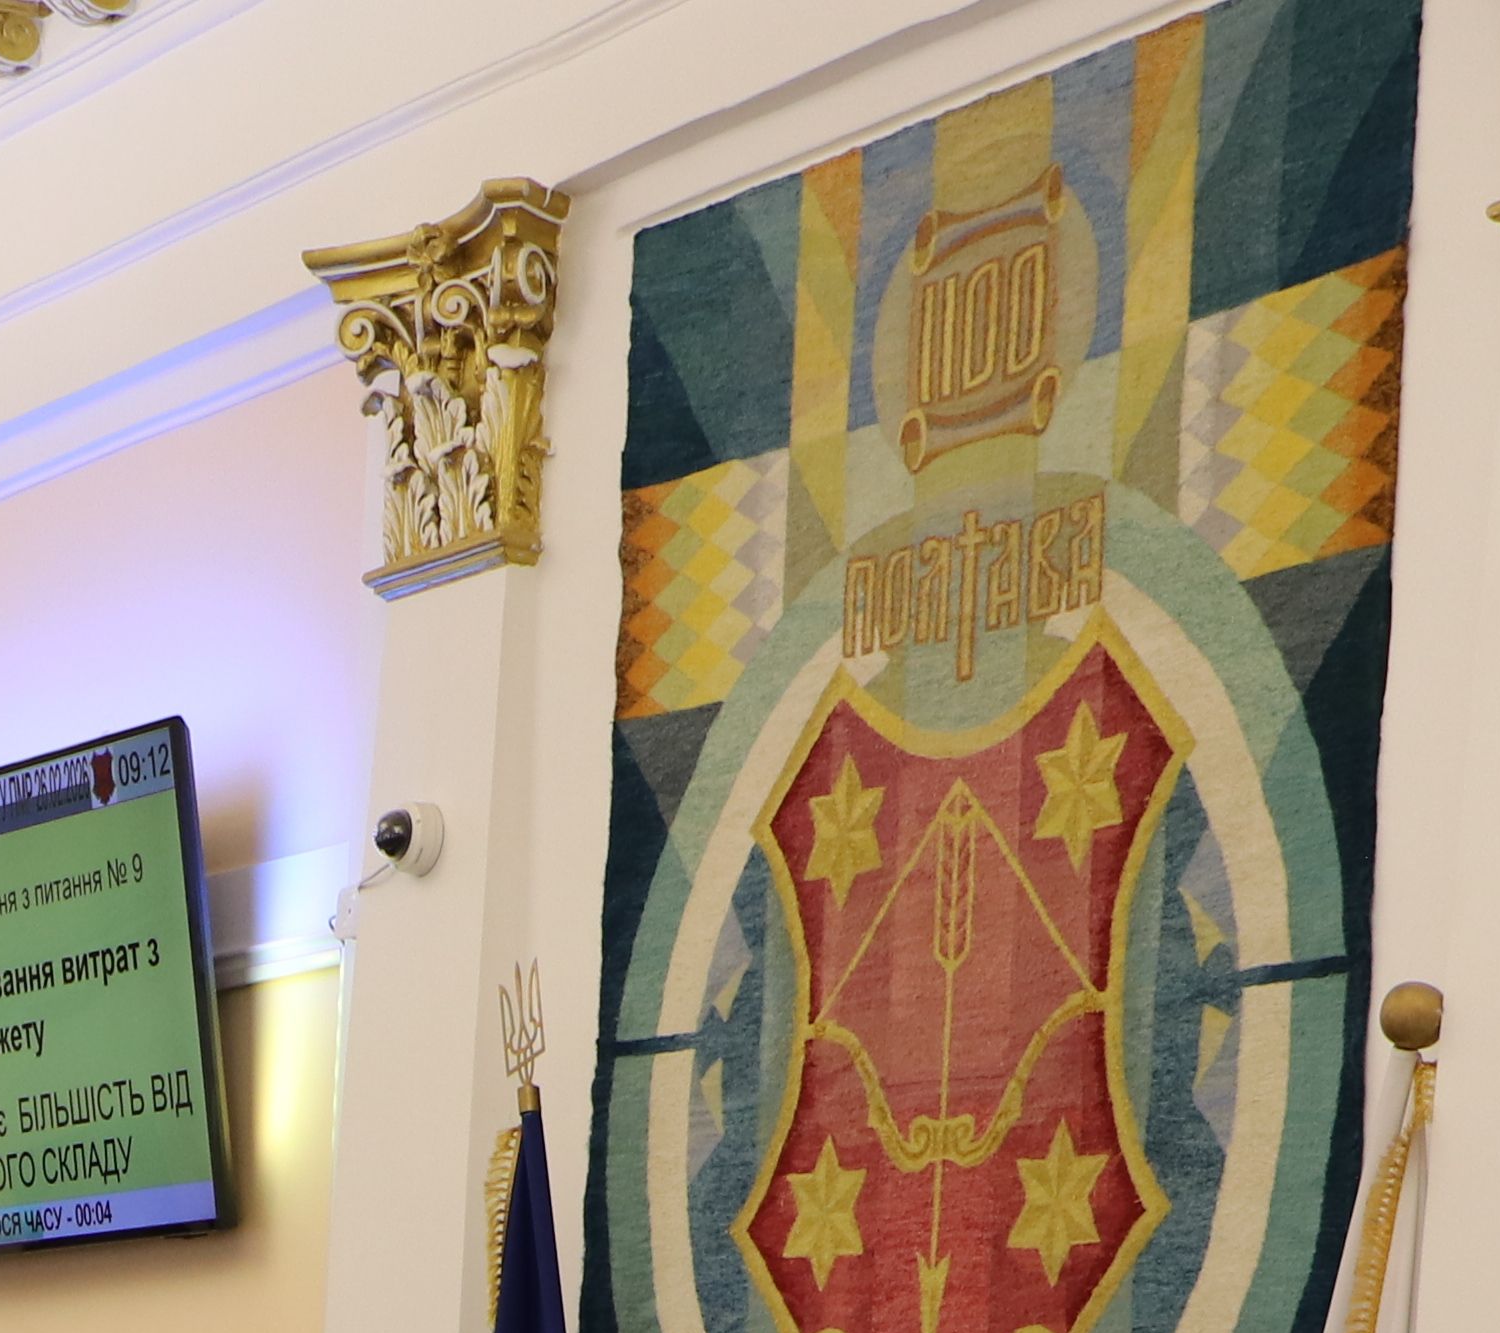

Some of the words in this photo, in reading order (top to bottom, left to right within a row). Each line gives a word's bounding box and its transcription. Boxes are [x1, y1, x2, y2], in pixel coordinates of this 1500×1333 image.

[920, 241, 1047, 404] 1100
[118, 743, 171, 788] 09:12
[22, 887, 31, 910] з
[34, 871, 103, 908] питання
[107, 857, 128, 888] №
[133, 852, 144, 884] 9
[61, 938, 140, 988] витрат
[146, 939, 160, 967] з
[18, 1075, 145, 1134] БІЛЬШІСТЬ
[151, 1068, 193, 1117] ВІД
[42, 1136, 133, 1185] СКЛАДУ
[25, 1208, 63, 1235] ЧАСУ
[75, 1198, 113, 1228] 00:04
